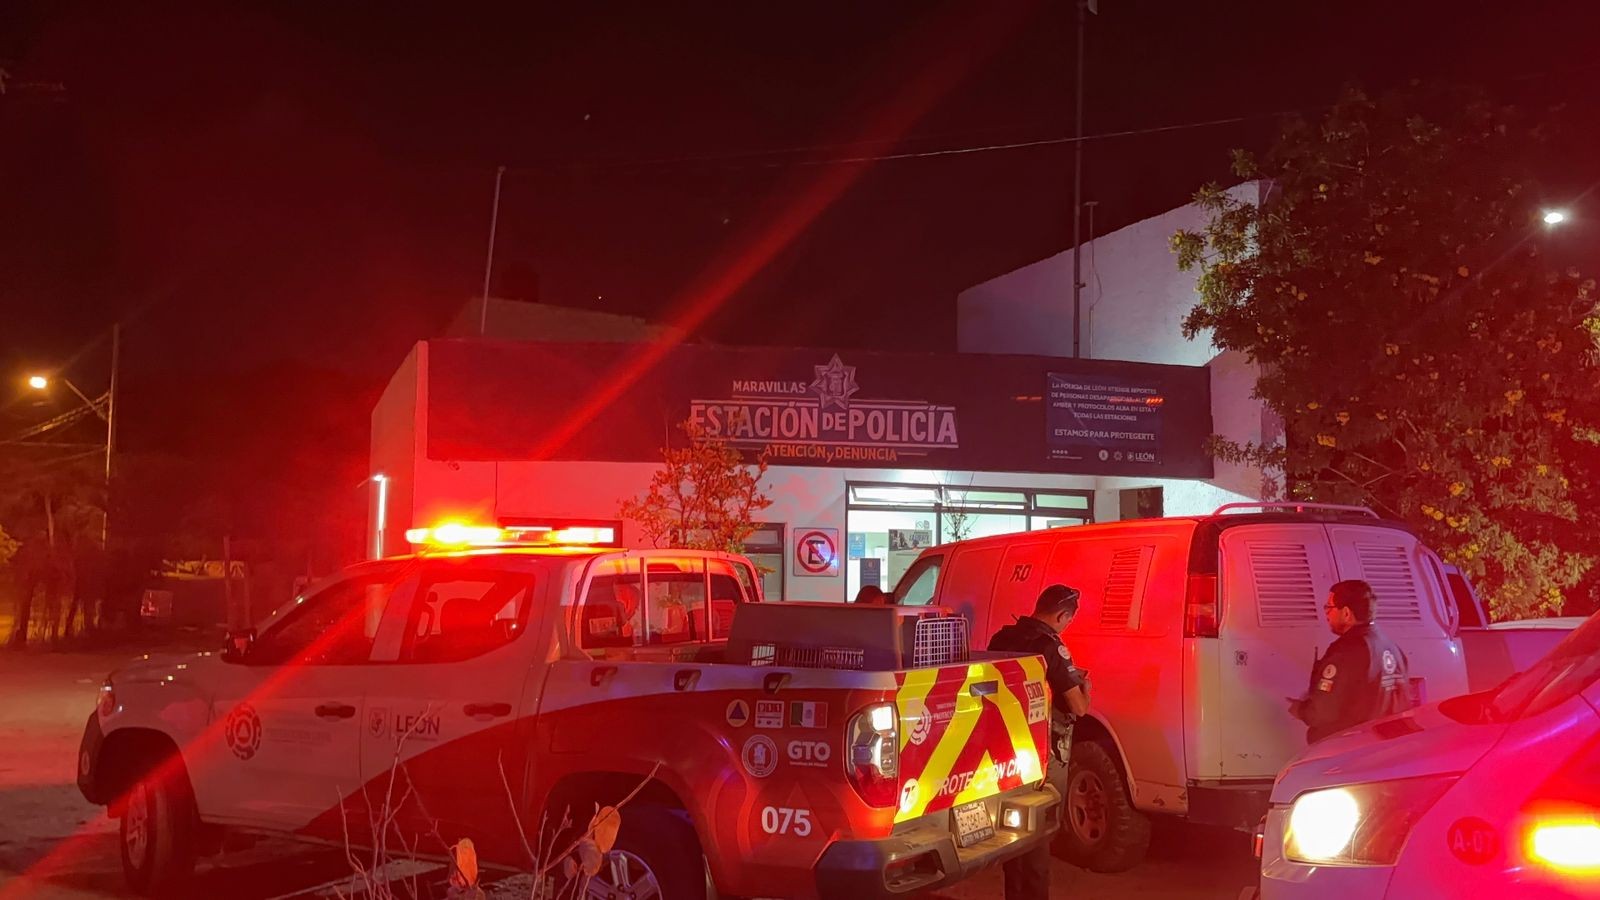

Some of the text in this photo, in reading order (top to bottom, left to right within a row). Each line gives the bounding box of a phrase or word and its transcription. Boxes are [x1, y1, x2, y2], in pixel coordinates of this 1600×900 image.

[732, 380, 806, 394] MARAVILLAS
[1059, 392, 1089, 400] PERSONAS
[1077, 402, 1115, 411] PROTOCOLOS
[690, 400, 958, 443] ESTACIÓN DE POLICÍA
[1073, 411, 1092, 419] TODAS
[1054, 428, 1155, 441] ESTAMOS PARA PROTEGERTE
[763, 442, 826, 459] ATENCIÓN
[834, 445, 897, 462] DENUNCIA
[1135, 451, 1155, 460] LEÓN
[787, 740, 831, 761] GTO
[761, 805, 812, 837] 075
[1453, 828, 1495, 855] A-07
